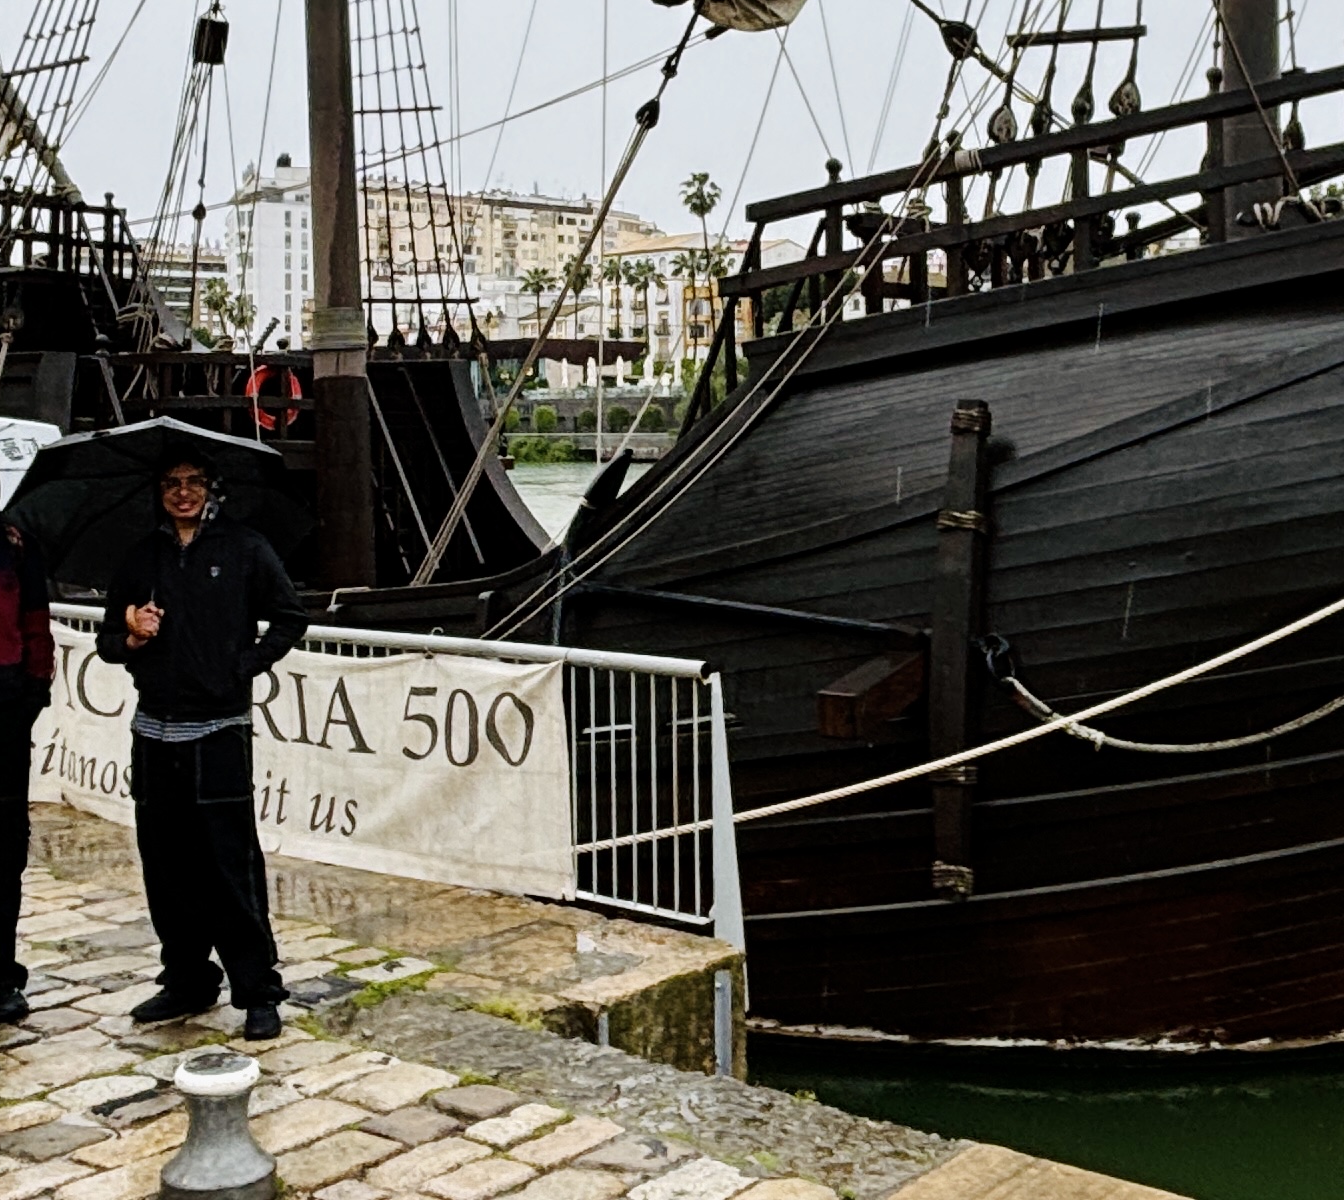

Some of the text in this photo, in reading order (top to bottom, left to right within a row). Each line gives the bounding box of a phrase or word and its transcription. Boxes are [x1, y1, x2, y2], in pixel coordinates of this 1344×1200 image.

[55, 644, 534, 767] ICRIA 500
[309, 793, 359, 837] us
